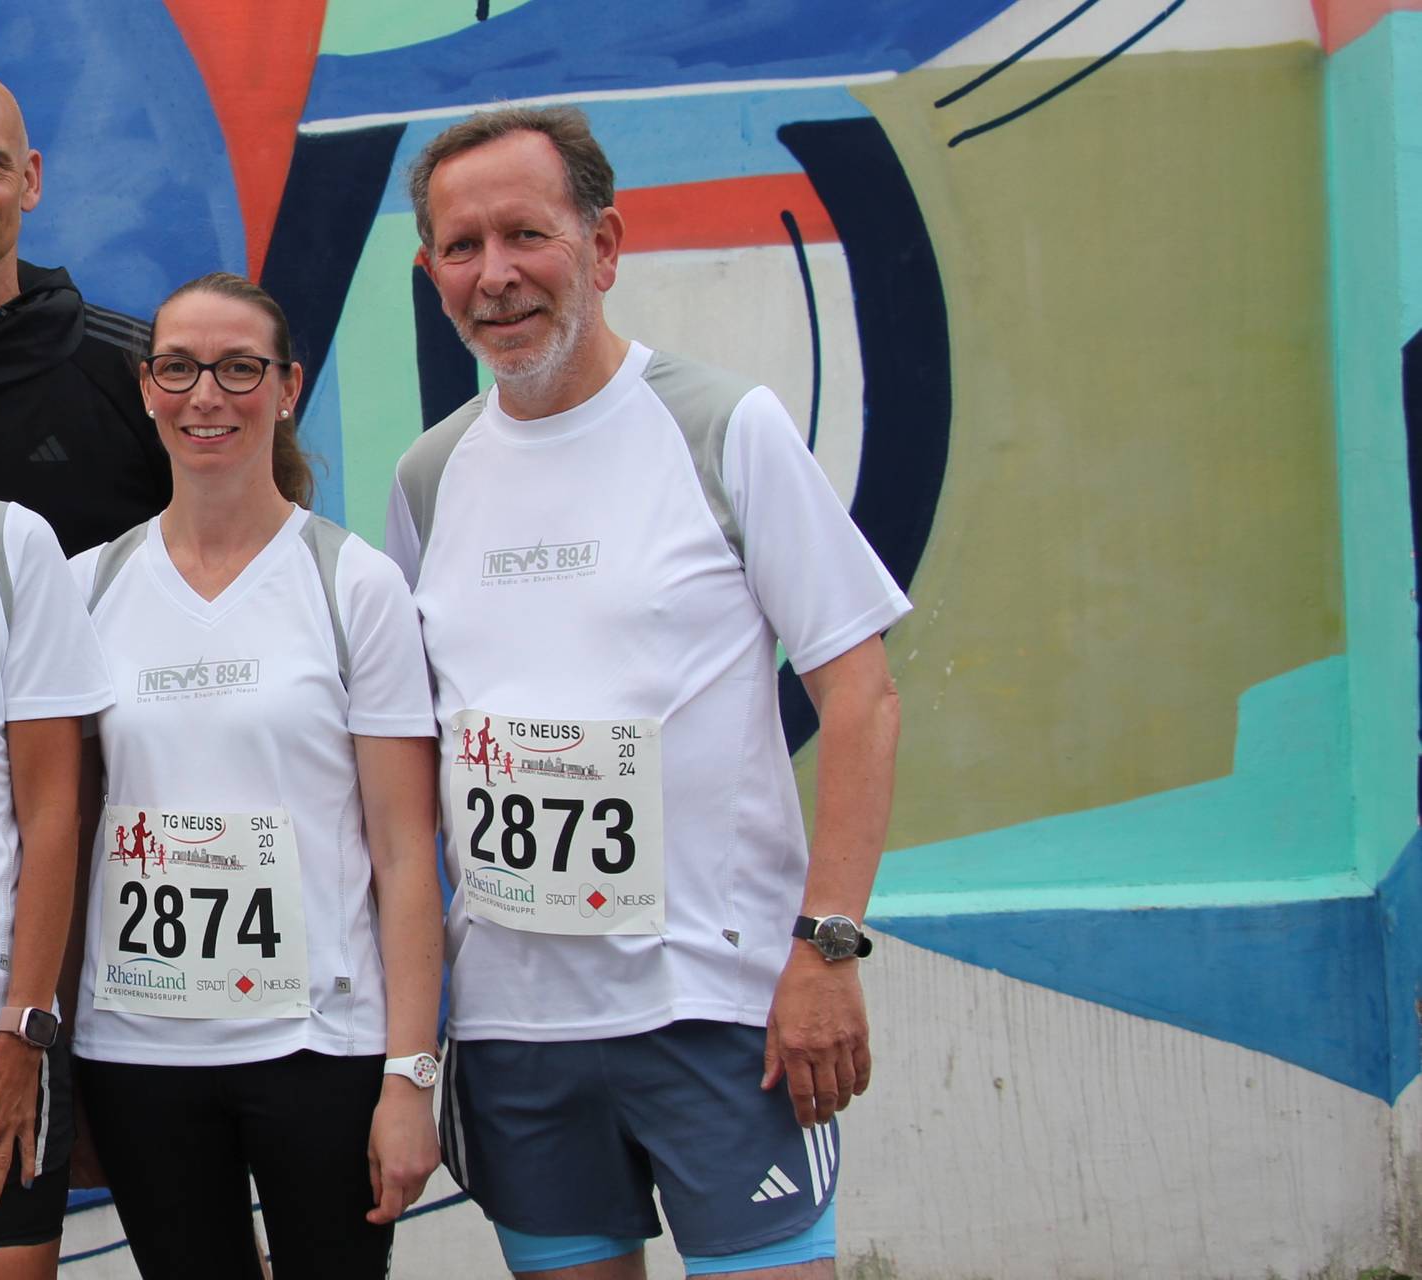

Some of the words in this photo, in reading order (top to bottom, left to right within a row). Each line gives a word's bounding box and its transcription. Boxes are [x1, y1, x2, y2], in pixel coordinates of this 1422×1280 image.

[556, 544, 592, 569] 89.4
[216, 662, 252, 685] 89.4
[508, 721, 526, 737] TG
[530, 723, 580, 740] NEUSS
[611, 726, 642, 741] SNL
[618, 743, 635, 758] 20
[619, 762, 635, 776] 24
[161, 814, 178, 829] TG
[182, 816, 223, 832] NEUSS
[251, 816, 278, 832] SNL
[467, 787, 636, 875] 2873
[258, 833, 274, 848] 20
[259, 852, 275, 866] 24
[465, 868, 535, 903] RheinLand
[545, 894, 577, 906] STADT
[617, 894, 655, 906] NEUSS
[118, 881, 281, 958] 2874
[106, 964, 186, 991] RheinLand
[196, 979, 226, 991] STADT
[264, 979, 300, 990] NEUSS
[104, 987, 187, 1001] VERSICHERUNGSGRUPPE
